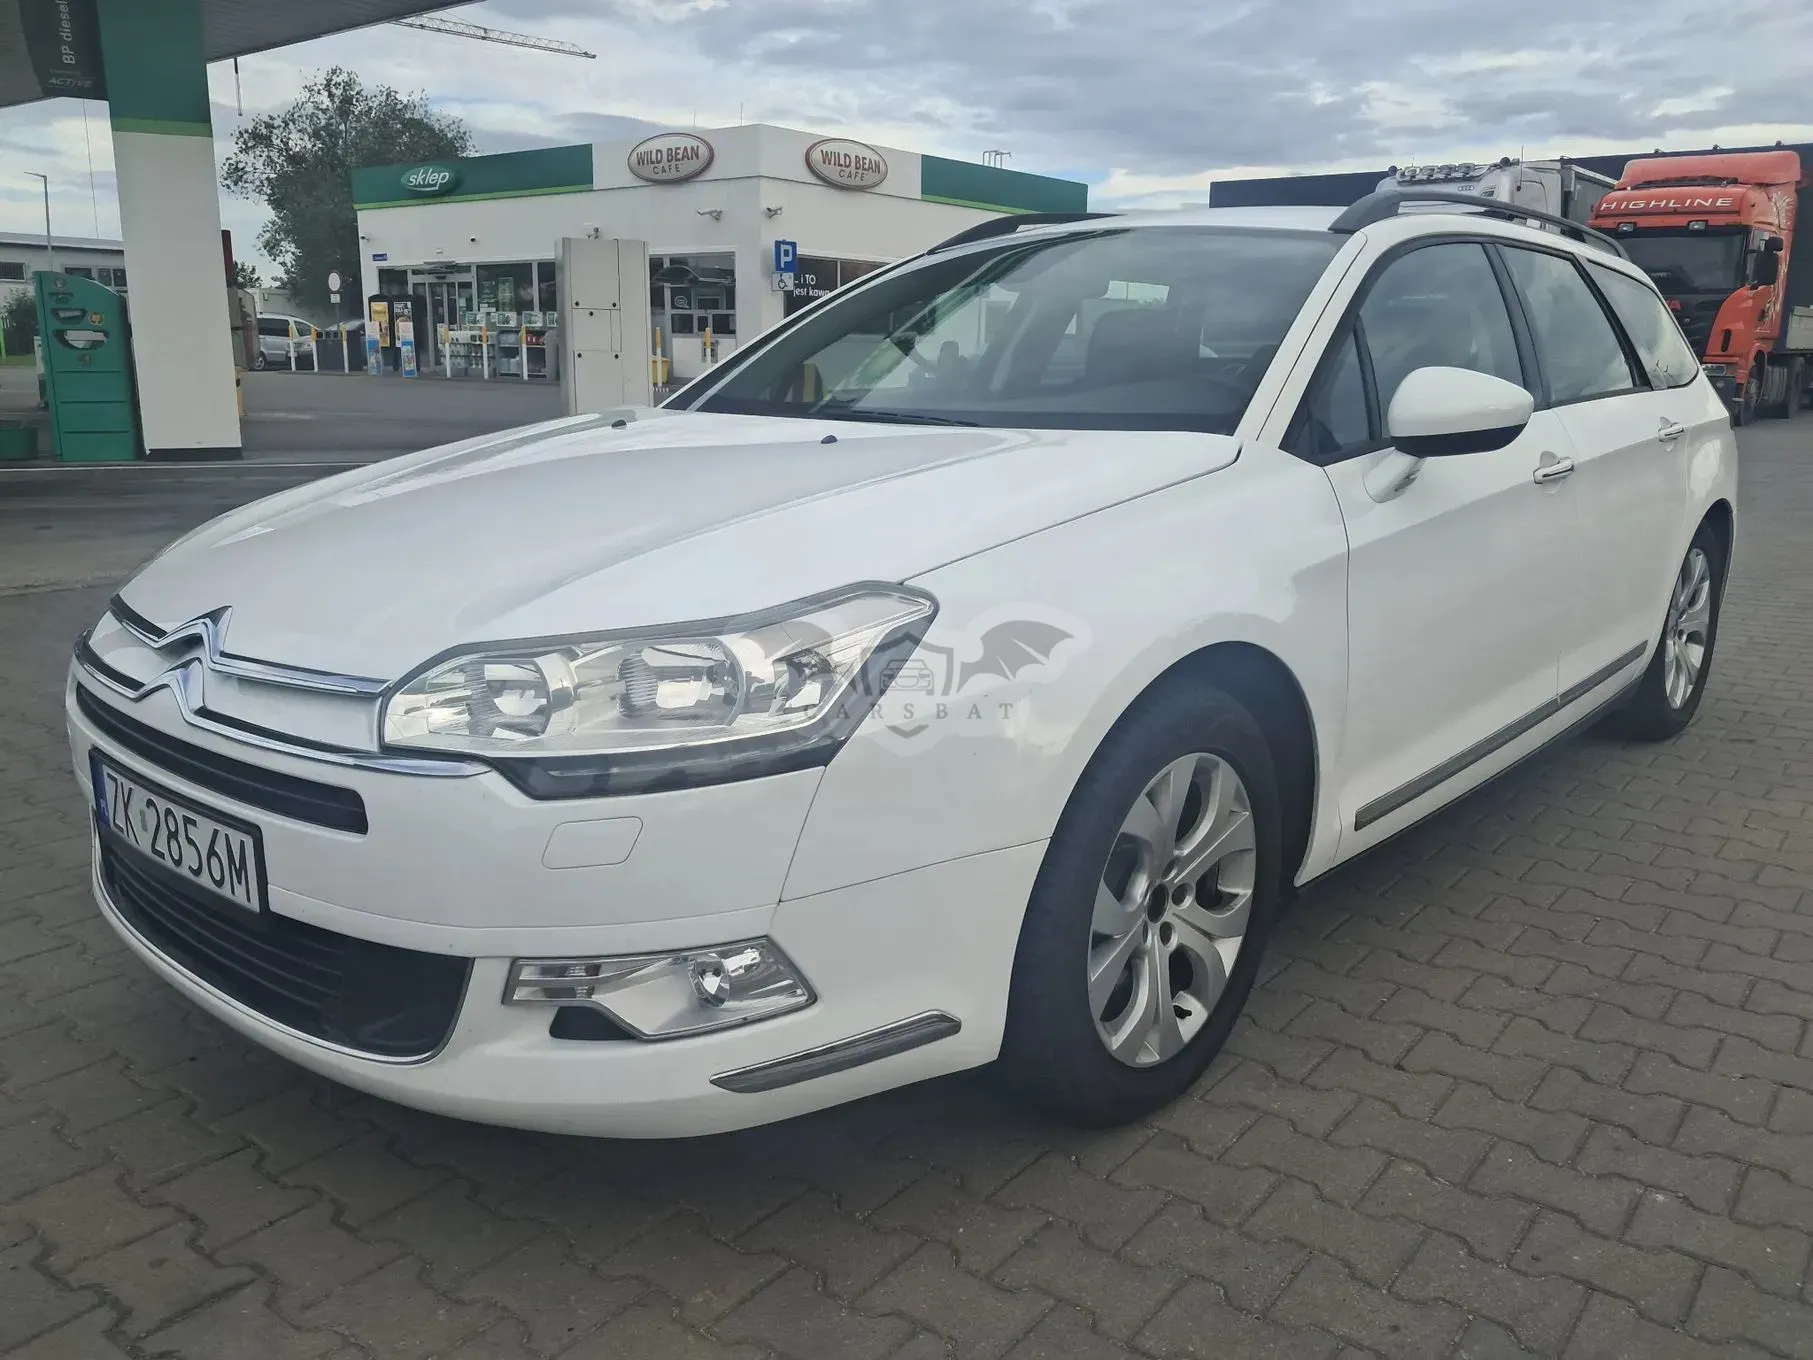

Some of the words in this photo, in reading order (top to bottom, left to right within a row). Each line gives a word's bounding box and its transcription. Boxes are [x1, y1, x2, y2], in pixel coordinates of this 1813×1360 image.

[55, 0, 72, 41] diesel
[61, 45, 75, 65] BP
[636, 149, 664, 166] WILD
[666, 145, 700, 163] BEAN
[820, 149, 851, 168] WILD
[854, 154, 881, 174] BEAN
[407, 168, 449, 190] sklep
[1599, 197, 1734, 211] HIGHLINE
[780, 244, 793, 269] P
[805, 274, 816, 285] TO
[793, 286, 807, 297] jest
[107, 771, 141, 847] ZK
[146, 797, 252, 904] 2856M
